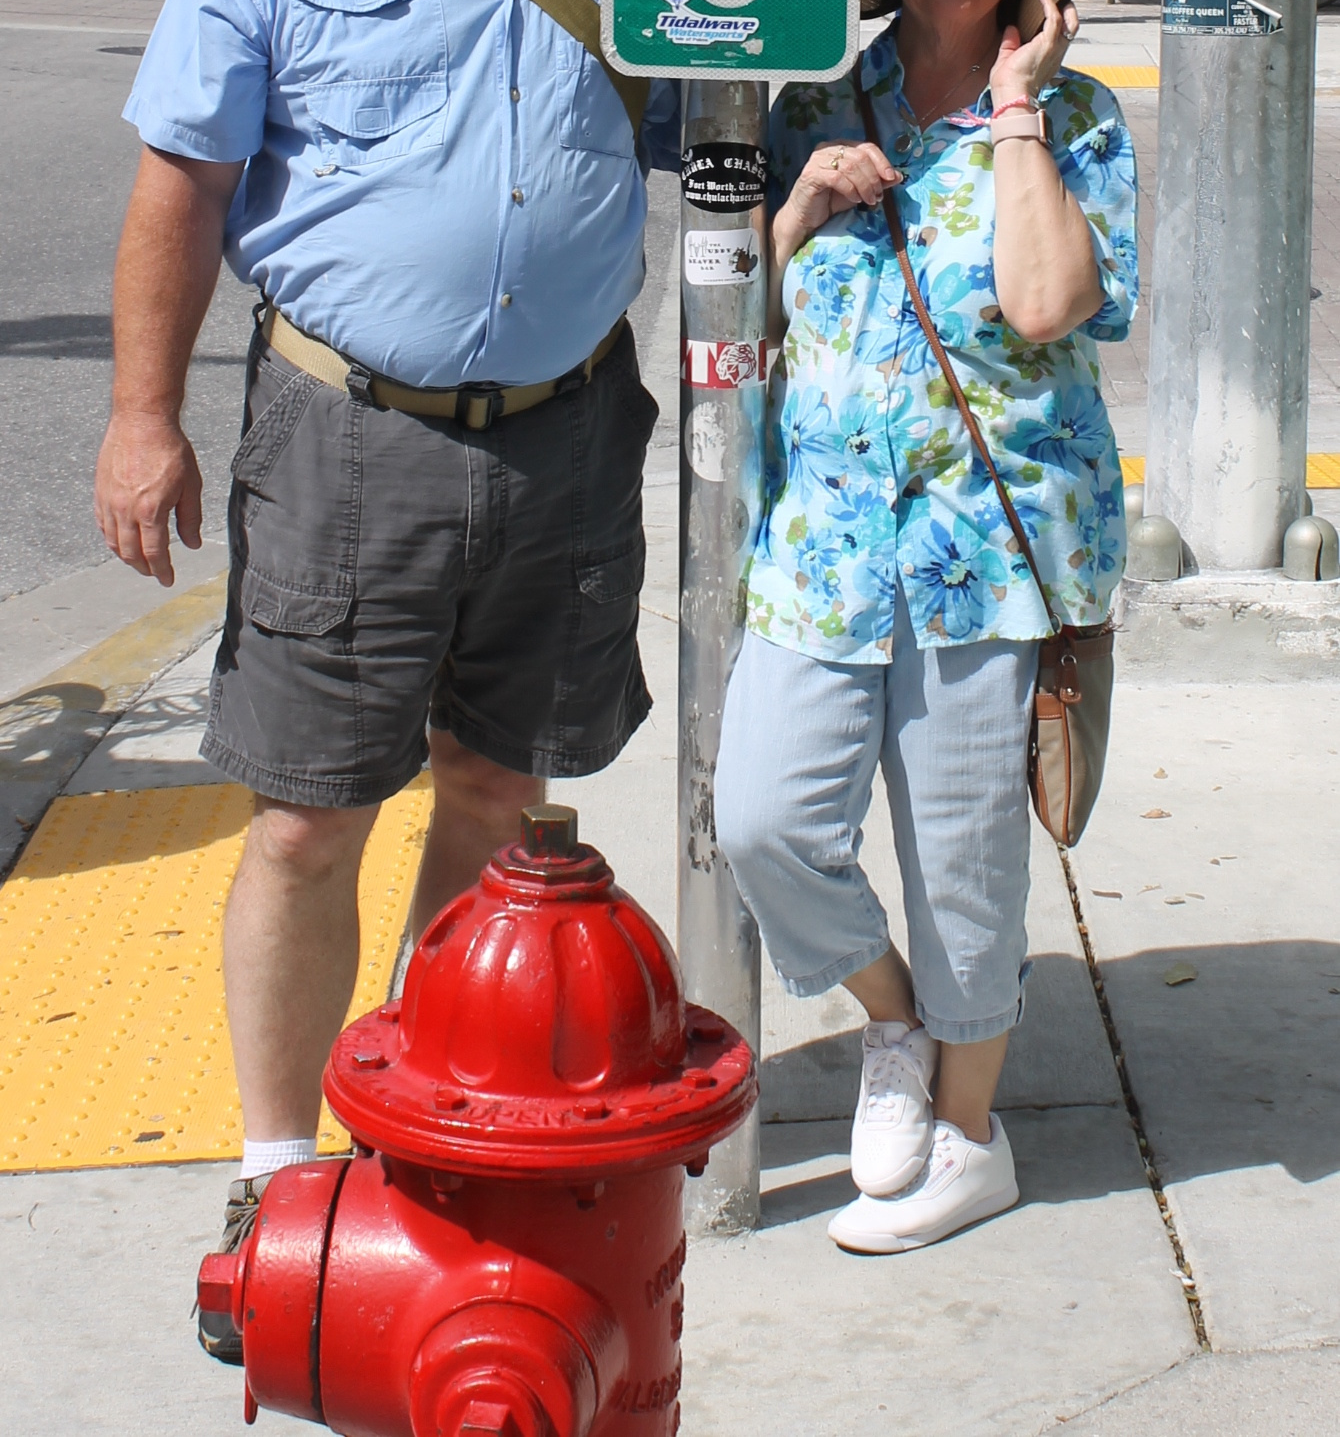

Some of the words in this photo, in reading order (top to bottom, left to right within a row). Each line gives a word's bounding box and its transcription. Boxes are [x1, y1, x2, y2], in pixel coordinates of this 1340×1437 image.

[1171, 7, 1195, 16] COFFEE
[1195, 7, 1225, 17] QUEEN
[659, 15, 756, 31] Tidalwave
[1233, 17, 1259, 26] FASTER
[669, 27, 745, 40] Watersports
[688, 178, 705, 190] Fort
[738, 181, 760, 191] Texas
